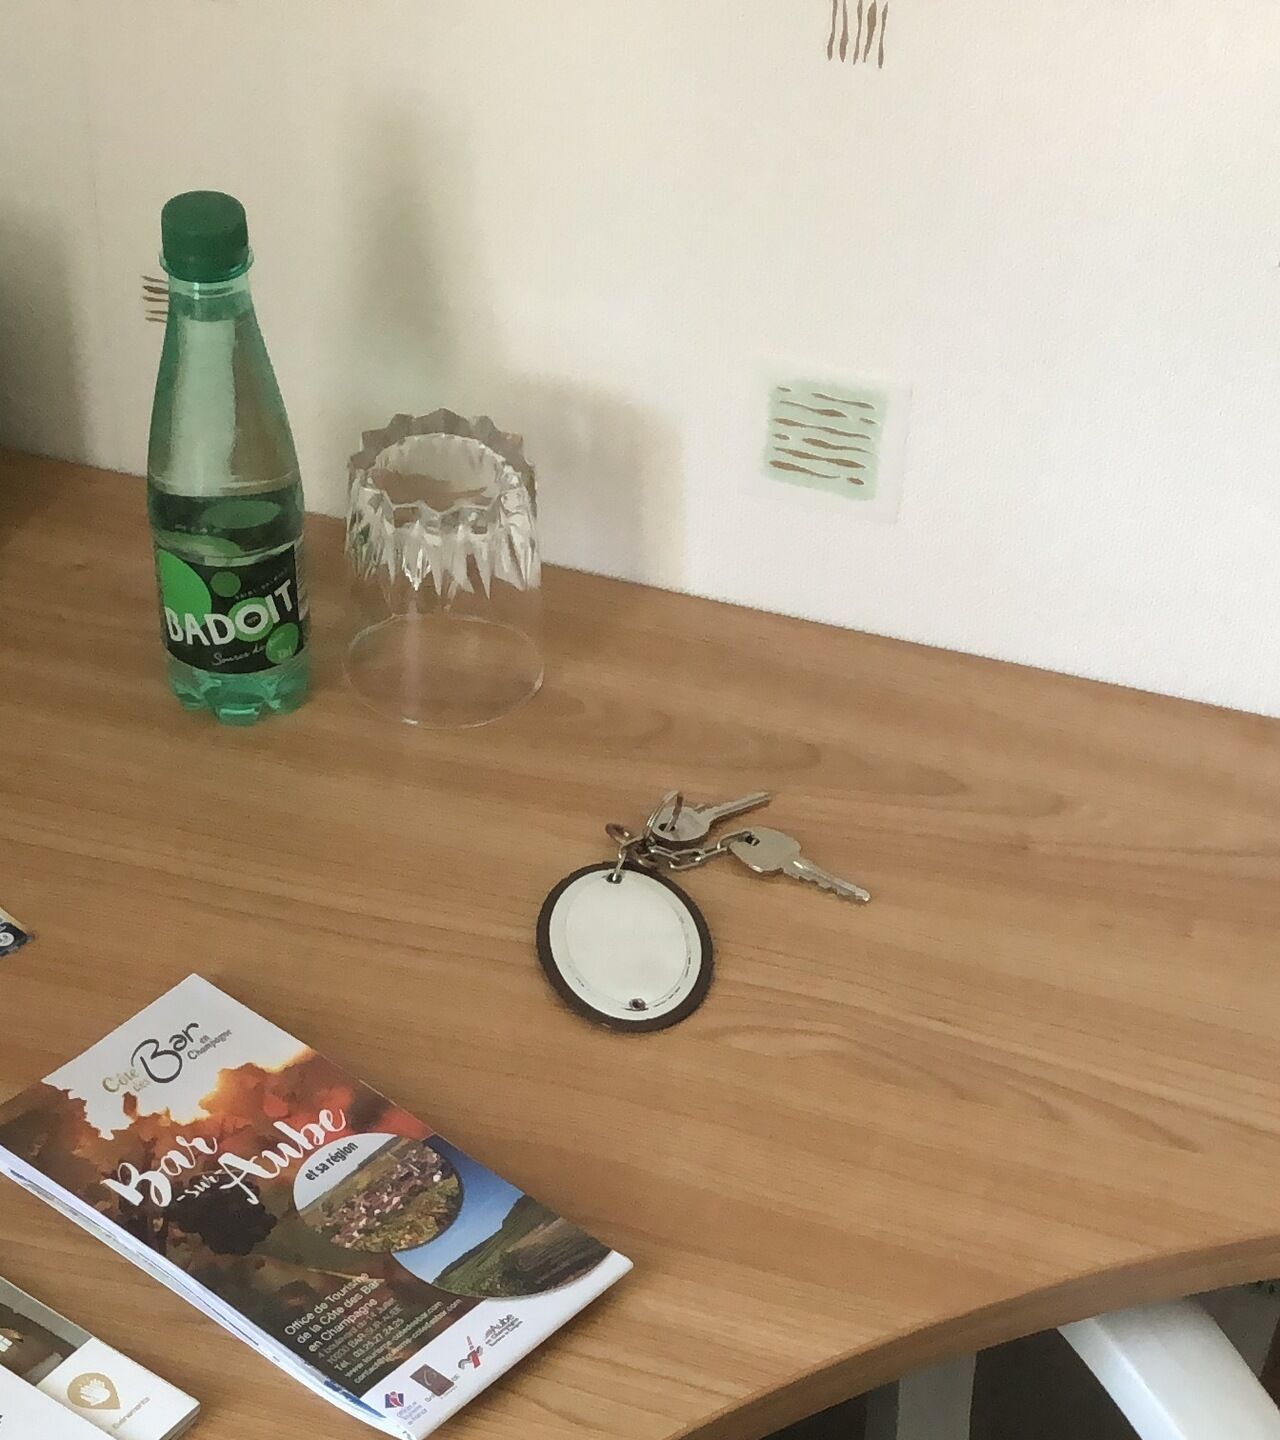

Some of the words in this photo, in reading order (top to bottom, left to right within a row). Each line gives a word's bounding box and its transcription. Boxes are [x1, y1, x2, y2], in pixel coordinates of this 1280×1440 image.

[164, 579, 293, 646] BADOIT
[131, 1022, 199, 1083] Bar
[100, 1135, 218, 1207] Bar
[217, 1108, 346, 1206] Aube
[305, 1169, 319, 1181] et
[315, 1162, 330, 1174] sa
[326, 1142, 359, 1166] région
[284, 1313, 316, 1336] Office
[314, 1301, 329, 1314] de
[297, 1331, 311, 1344] de
[312, 1322, 323, 1334] la
[321, 1305, 345, 1325] Côte
[343, 1292, 364, 1308] des
[360, 1280, 380, 1295] Bar
[308, 1340, 323, 1353] en
[320, 1298, 378, 1341] Champagne
